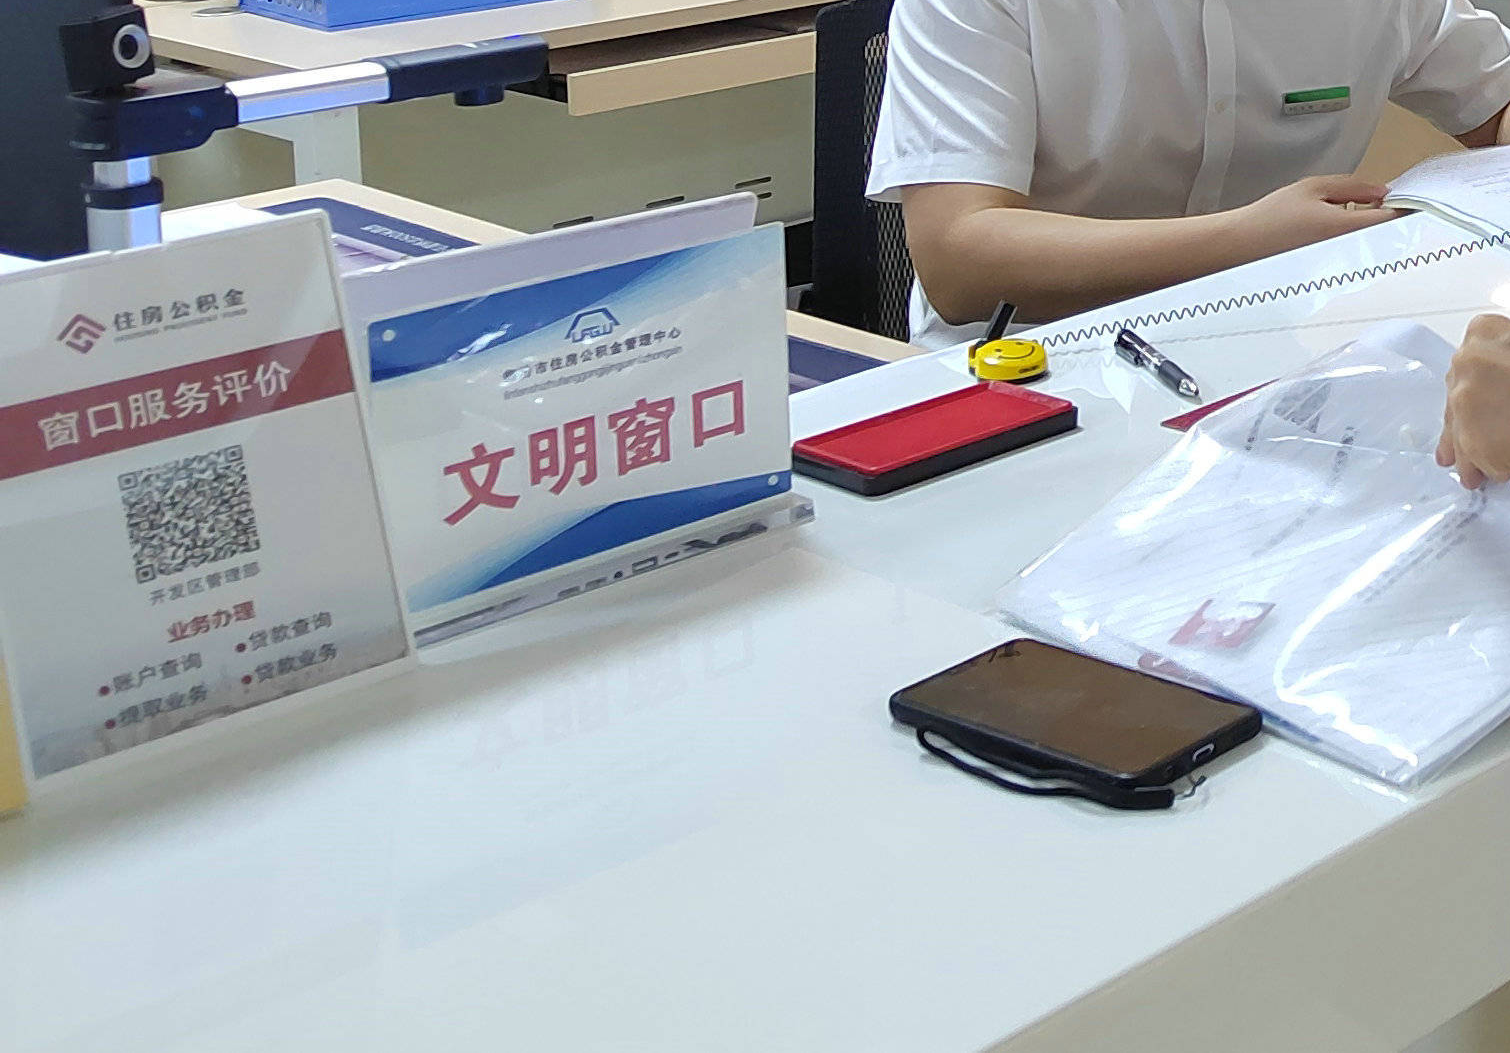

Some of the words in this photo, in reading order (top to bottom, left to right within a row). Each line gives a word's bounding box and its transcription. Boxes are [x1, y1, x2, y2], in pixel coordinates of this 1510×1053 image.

[114, 288, 246, 332] 住房公积金
[502, 326, 682, 380] 市住房公积金管理中心
[39, 361, 292, 451] 窗口服务评价
[443, 379, 745, 526] 文明窗口
[150, 562, 260, 605] 开发区管理部
[168, 601, 256, 643] 业务办理
[113, 652, 202, 694] 账户查询
[249, 612, 332, 651] 贷款查询
[255, 643, 337, 683] 贷款业务
